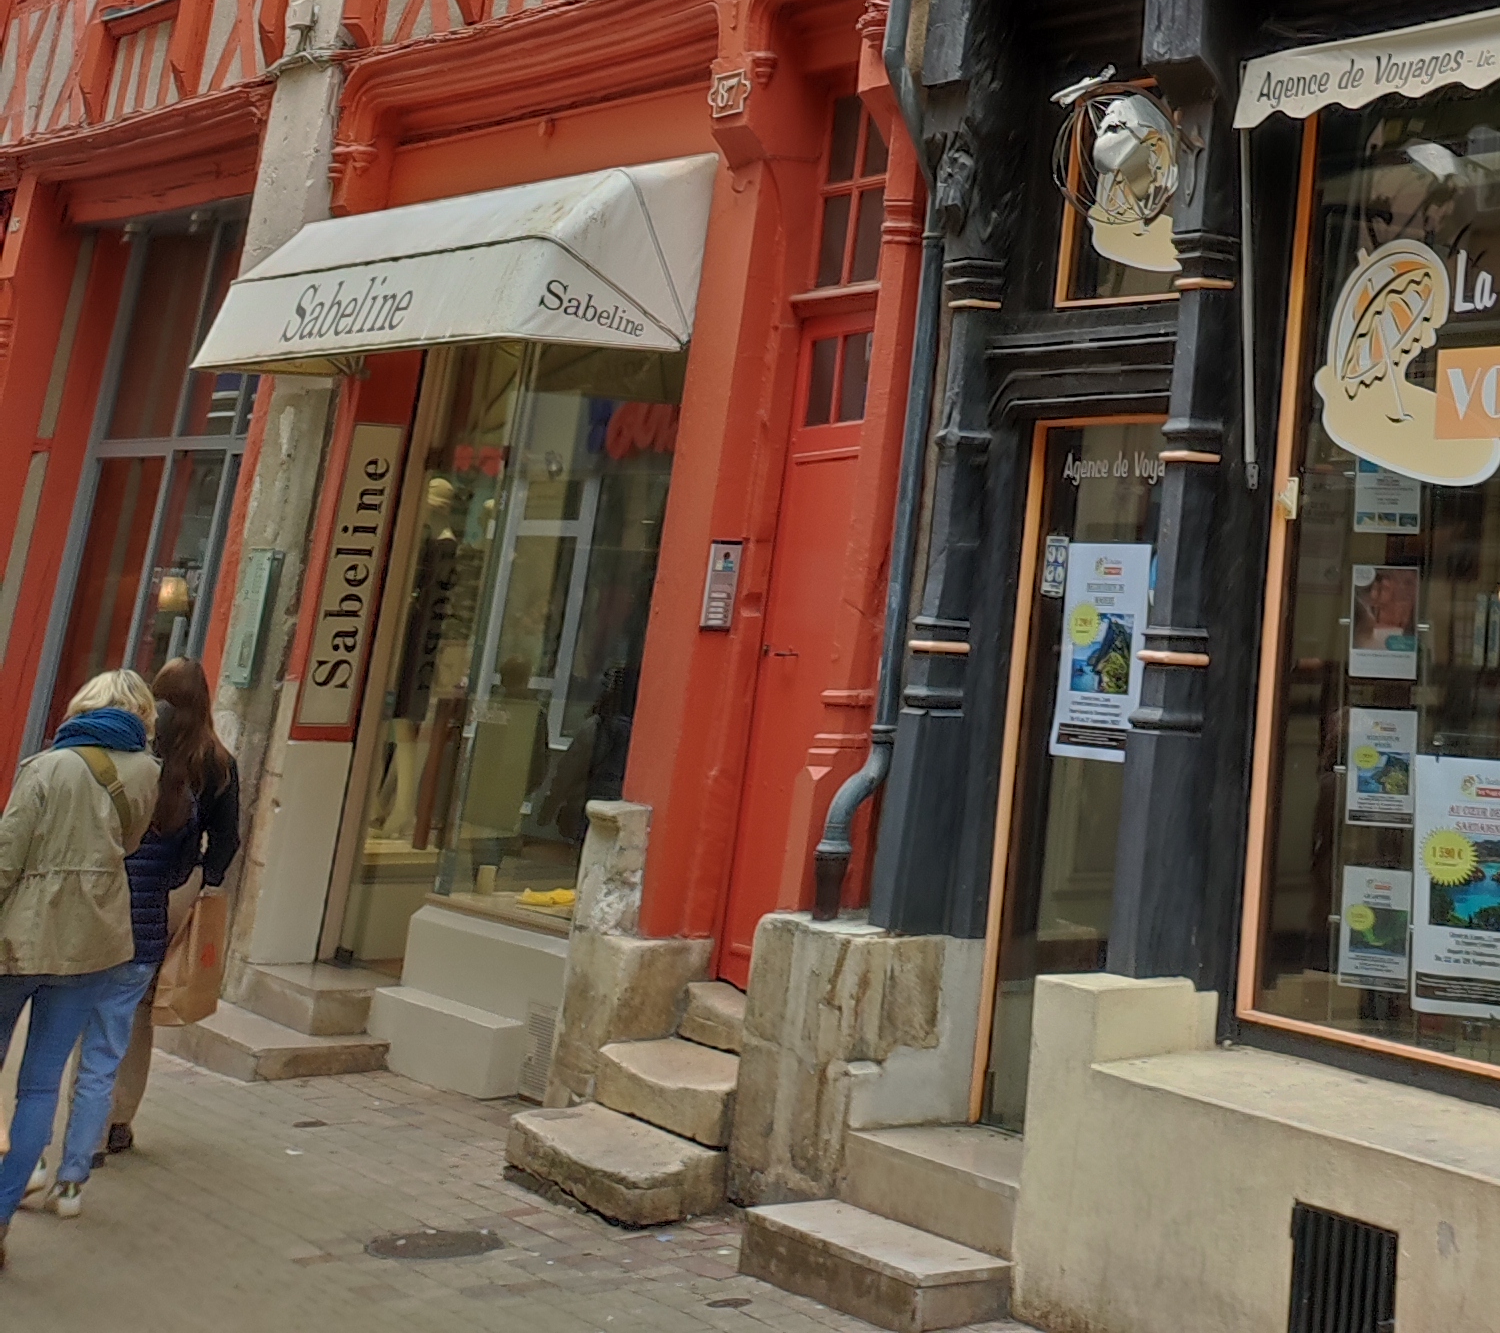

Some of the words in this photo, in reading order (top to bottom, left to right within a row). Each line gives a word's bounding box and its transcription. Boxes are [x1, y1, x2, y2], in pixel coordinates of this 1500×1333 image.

[717, 77, 741, 107] 87
[1256, 70, 1329, 108] Agence
[1337, 58, 1364, 90] de
[1375, 49, 1465, 90] Voyages
[279, 276, 414, 344] Sabeline
[538, 278, 645, 338] Sabeline
[1453, 248, 1498, 314] La
[1063, 449, 1109, 486] Agence
[1113, 450, 1129, 478] de
[312, 455, 391, 690] Sabeline
